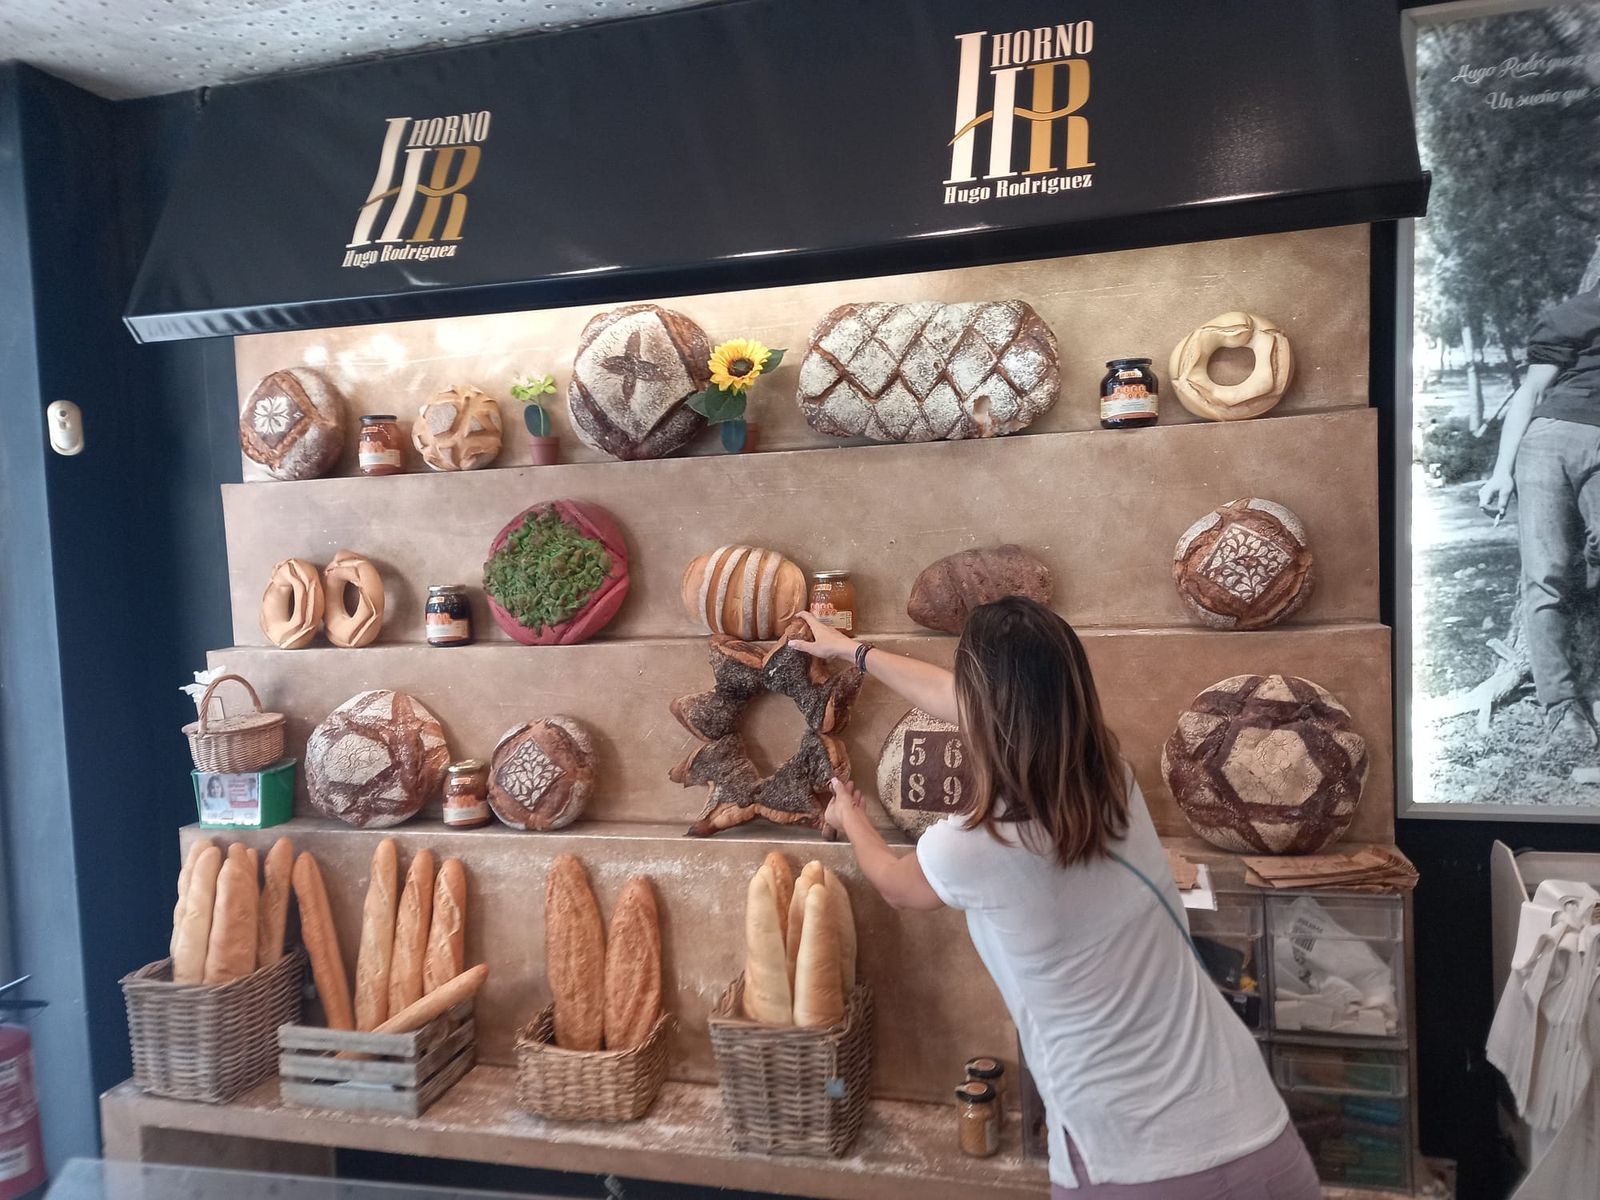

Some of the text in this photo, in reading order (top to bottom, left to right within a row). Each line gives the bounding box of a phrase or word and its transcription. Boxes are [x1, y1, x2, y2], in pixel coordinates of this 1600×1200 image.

[990, 20, 1095, 67] HORNO
[1451, 64, 1497, 85] Hugo
[1485, 91, 1514, 109] Un
[406, 111, 492, 147] HORNO
[943, 186, 991, 204] Hugo
[342, 250, 378, 268] Hugo
[909, 737, 963, 768] 5 6
[908, 773, 962, 805] 8 9
